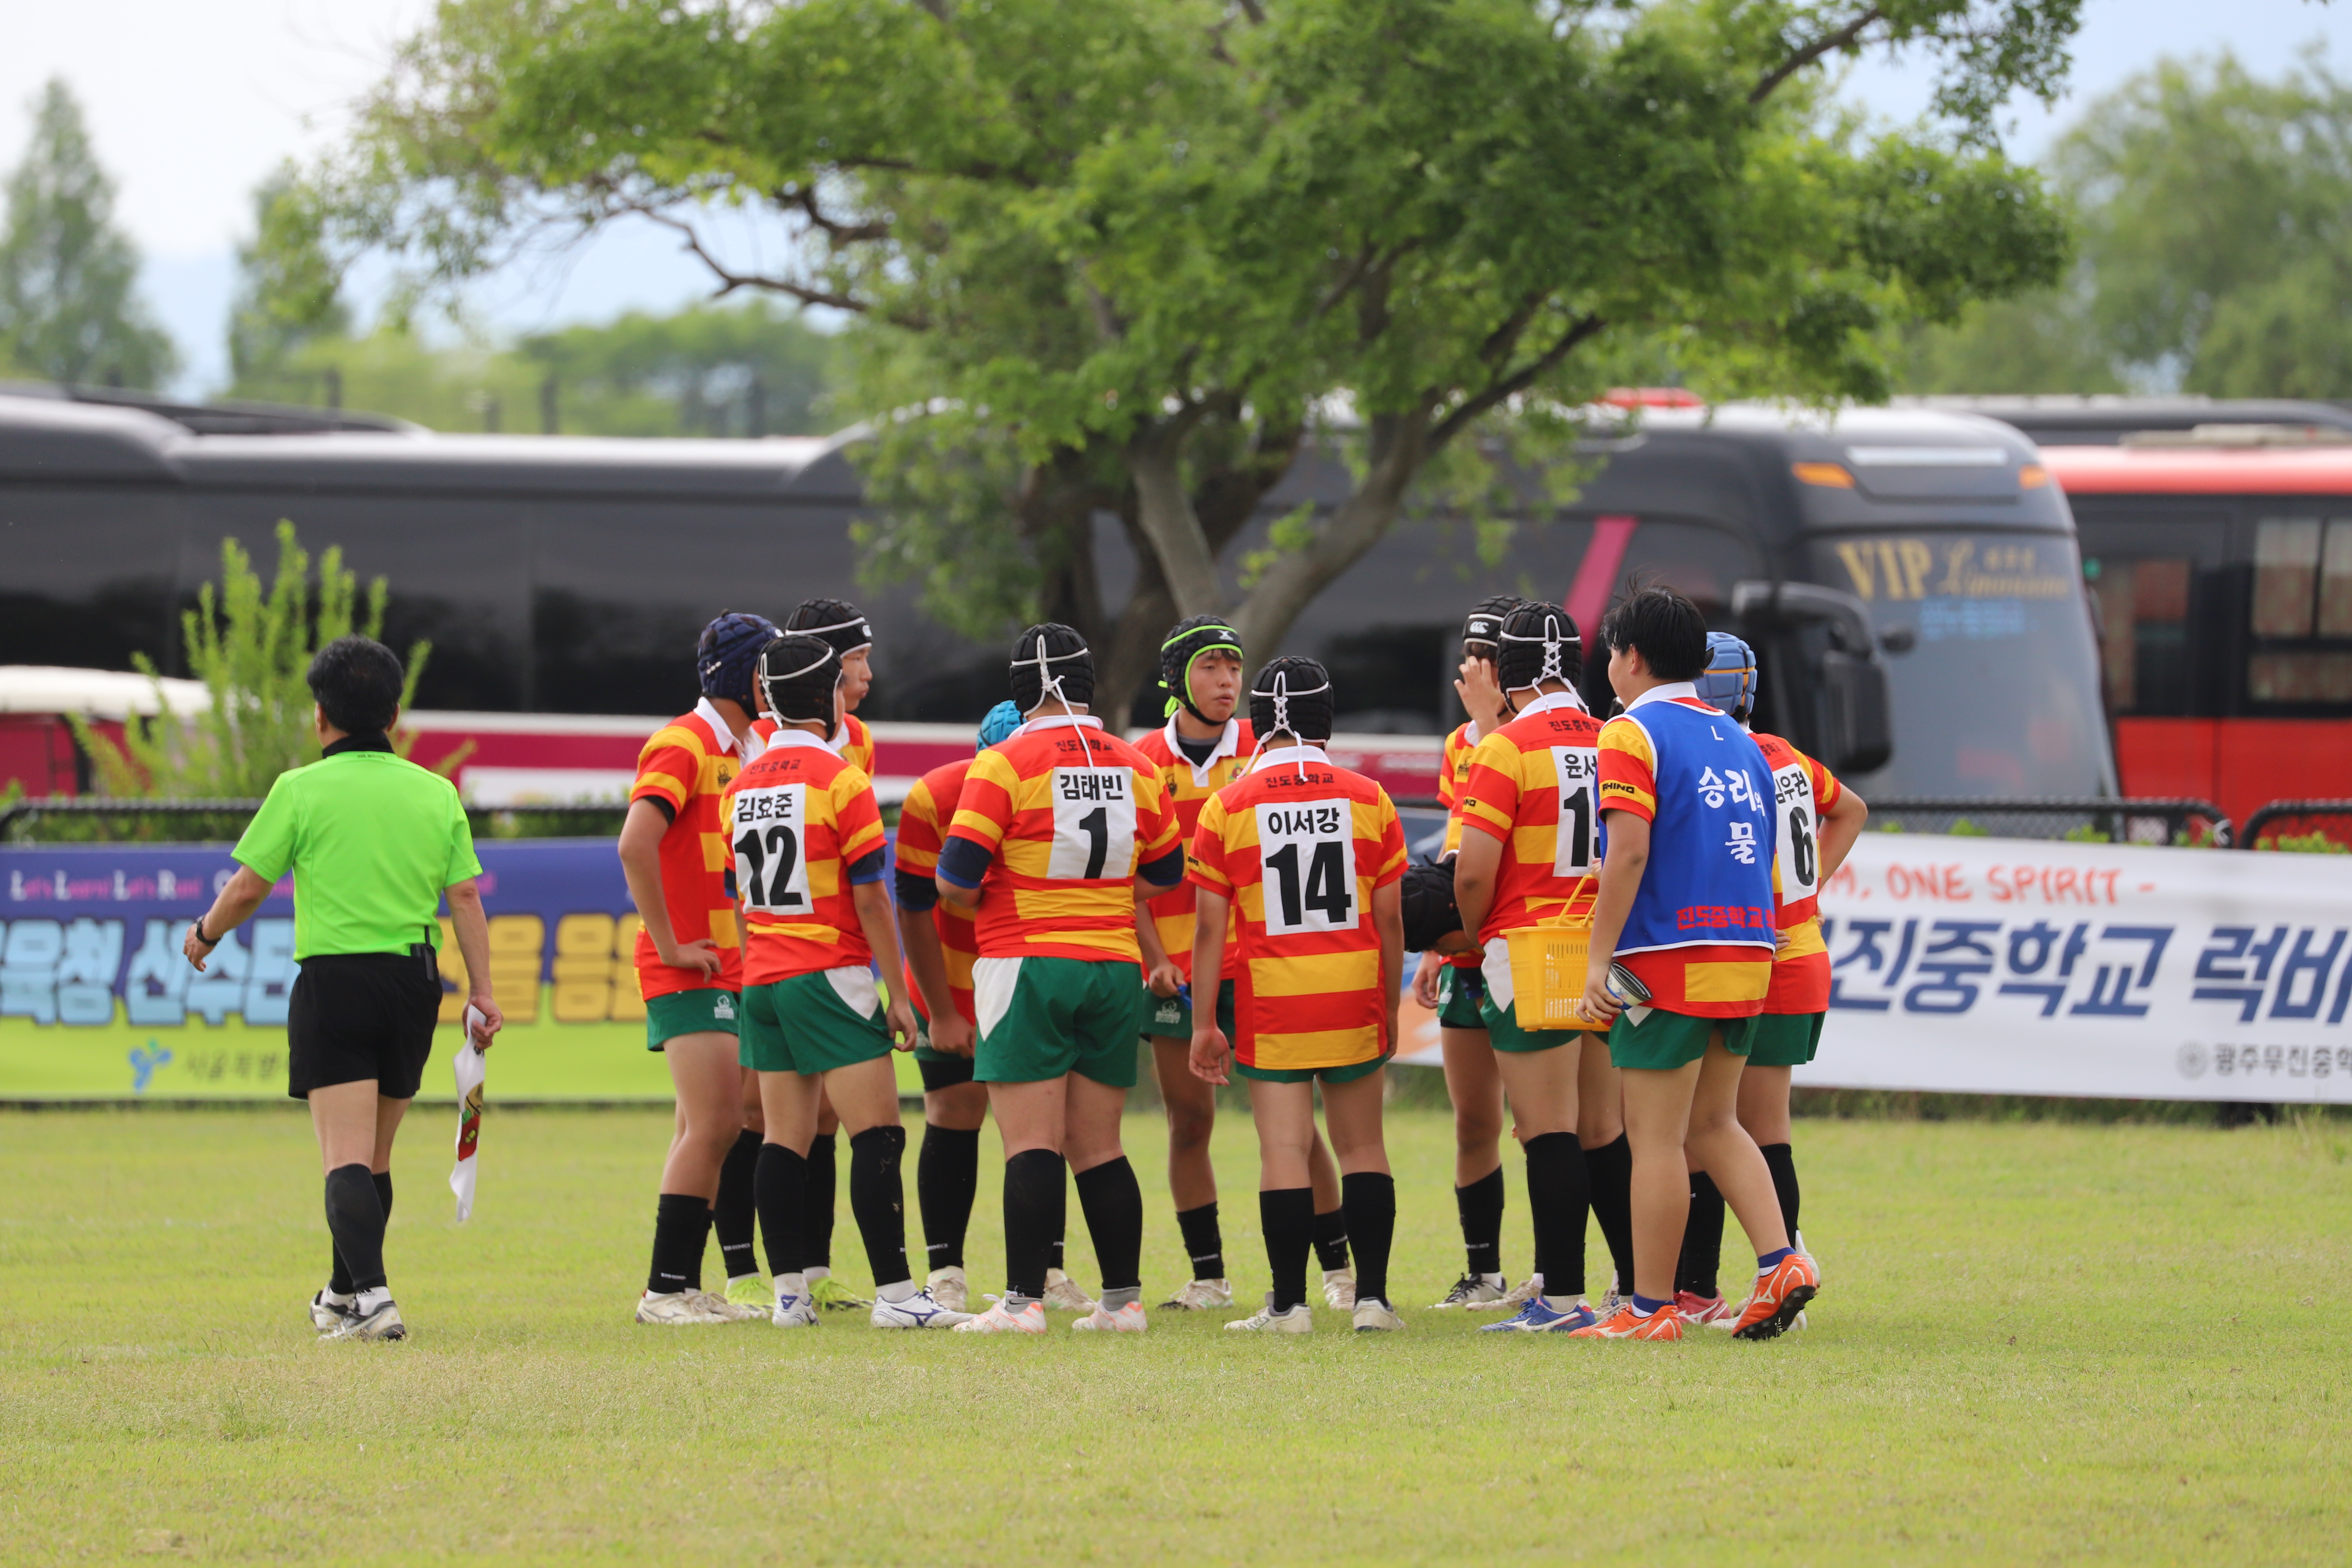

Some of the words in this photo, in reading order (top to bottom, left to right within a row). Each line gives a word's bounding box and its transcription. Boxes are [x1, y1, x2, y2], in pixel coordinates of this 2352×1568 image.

[1836, 540, 1931, 599] VIP
[1710, 725, 1724, 741] L
[1759, 742, 1781, 756] 중학교
[1265, 773, 1334, 788] 진도중학교
[1565, 754, 1597, 779] 윤서
[1060, 775, 1123, 801] 김태빈
[1603, 782, 1634, 794] RHINO
[737, 793, 792, 822] 김효준
[1268, 807, 1340, 835] 이서강
[1080, 807, 1108, 879] 1
[1725, 822, 1756, 864] 물
[1790, 807, 1814, 886] 6
[735, 825, 803, 905] 12
[1266, 841, 1351, 925] 14
[1887, 863, 1973, 902] ONE
[1986, 864, 2123, 905] SPIRIT
[1677, 906, 1764, 931] 진도중학교
[0, 918, 124, 1026] 육청
[1822, 918, 2175, 1017] 진중학교
